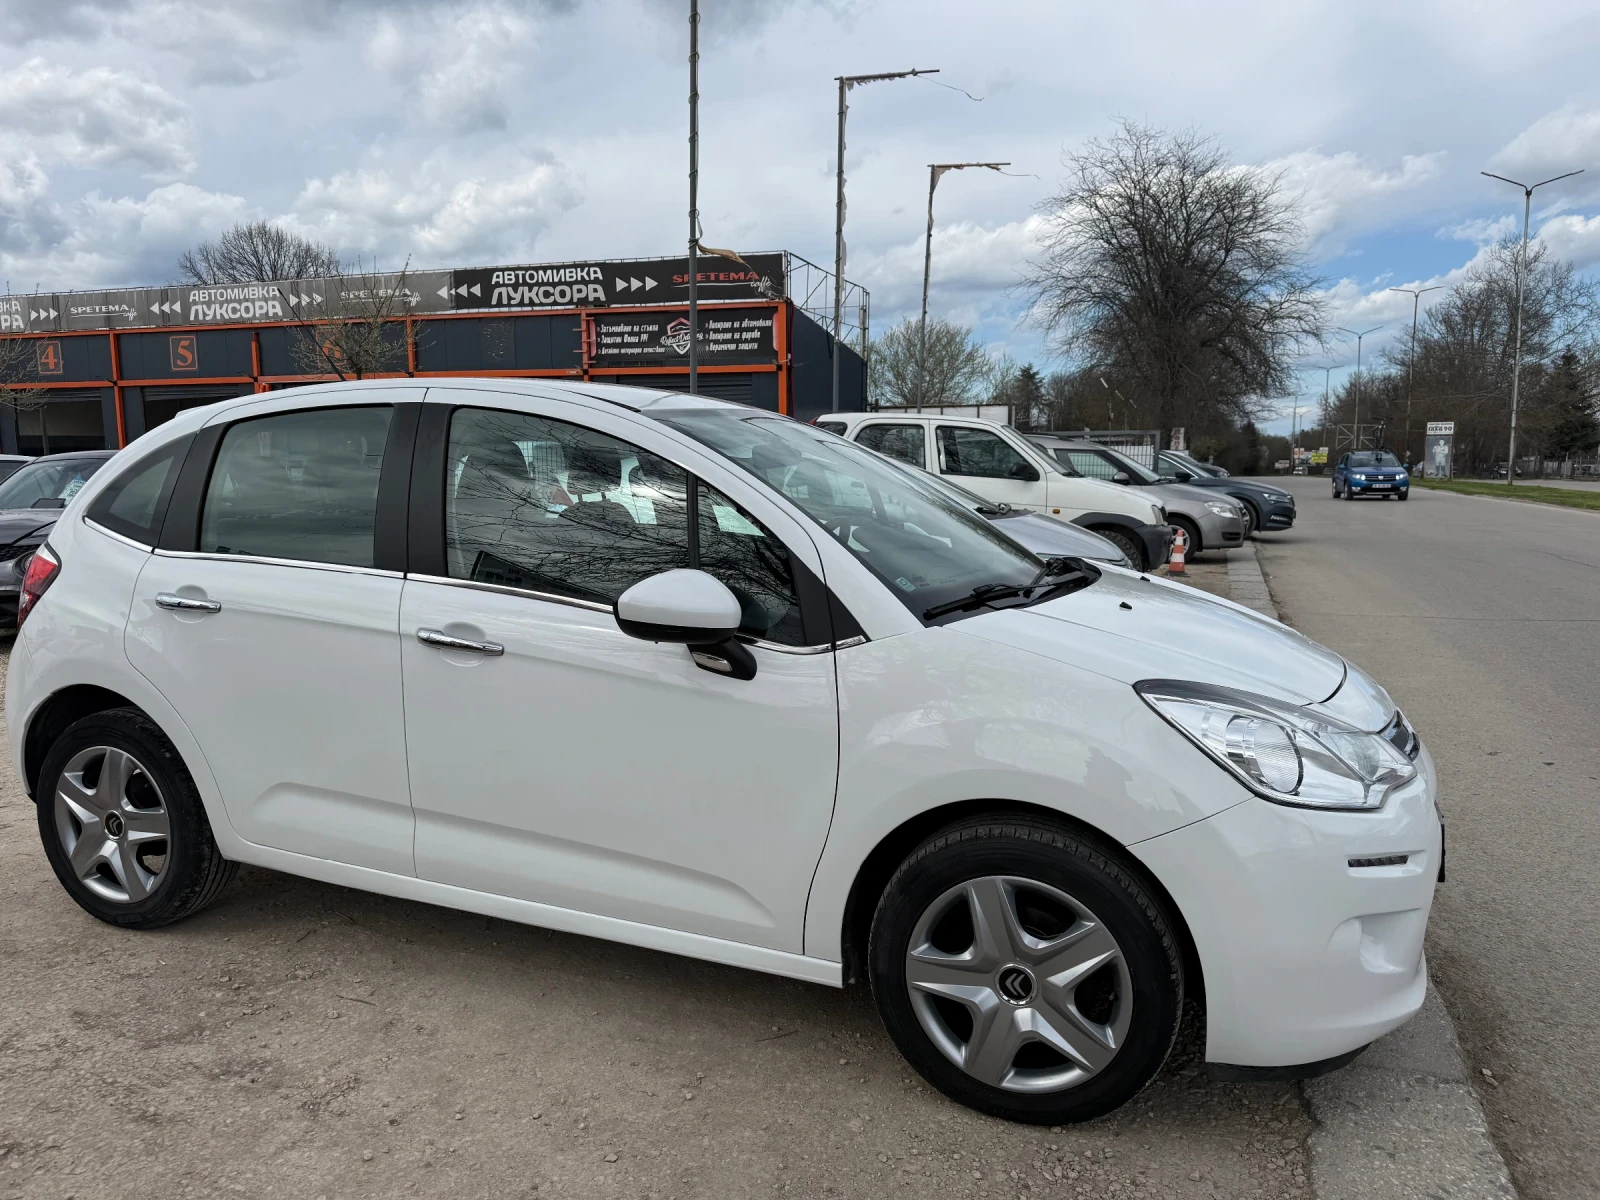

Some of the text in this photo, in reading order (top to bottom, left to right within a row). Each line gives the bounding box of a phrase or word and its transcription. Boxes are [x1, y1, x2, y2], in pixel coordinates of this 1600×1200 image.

[491, 267, 603, 284] АВТОМИВКА
[189, 286, 279, 302] АВТОМИВКА
[491, 284, 606, 305] ЛУКСОРА
[70, 304, 129, 314] SPETEMA
[189, 300, 282, 321] ЛУКСОРА
[40, 345, 58, 370] 4
[176, 340, 193, 366] 5
